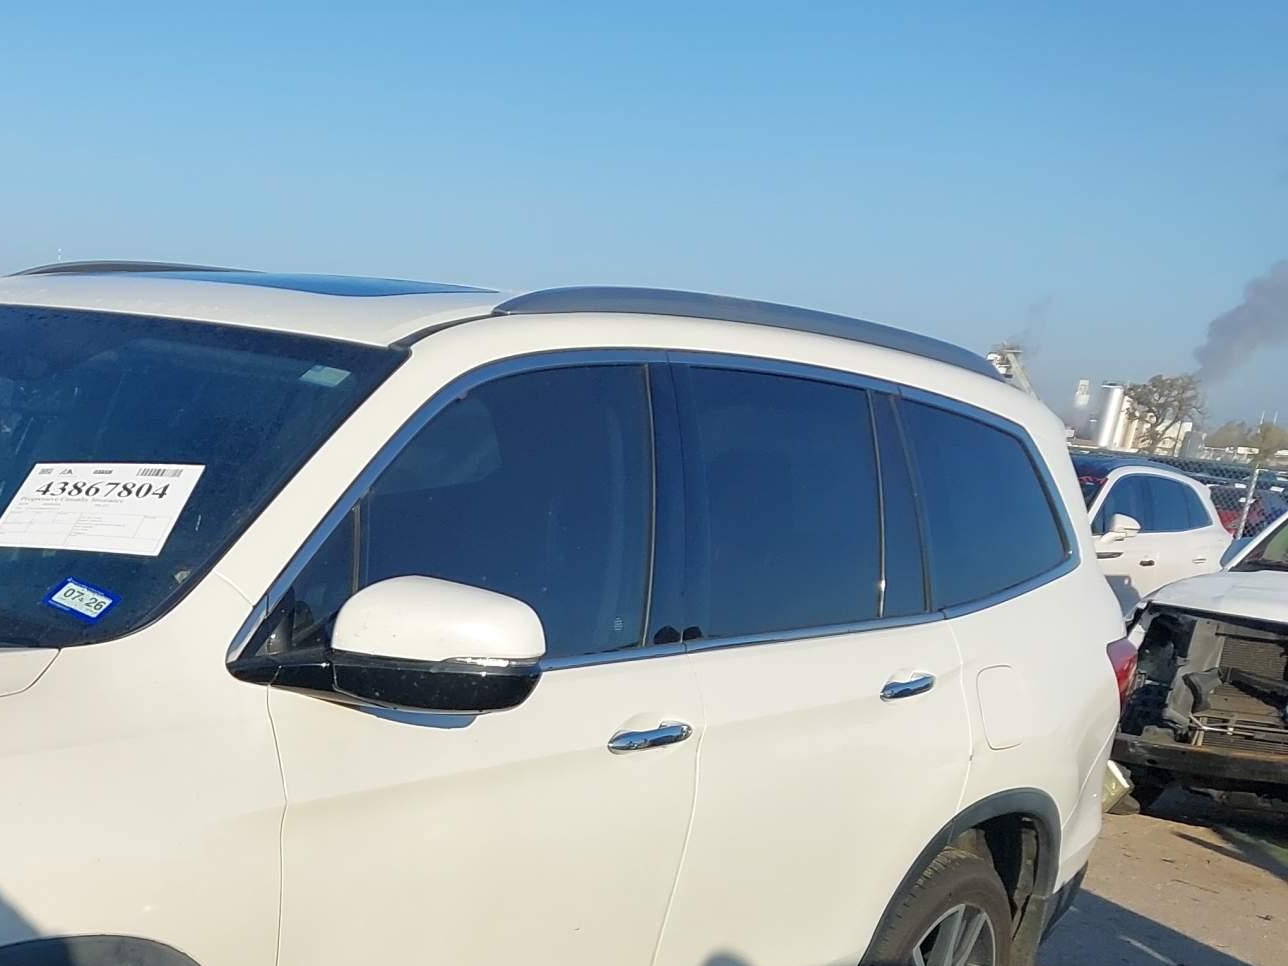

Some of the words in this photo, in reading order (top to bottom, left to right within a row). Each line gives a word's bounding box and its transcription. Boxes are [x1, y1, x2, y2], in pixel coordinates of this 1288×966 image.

[36, 481, 170, 499] 43867804
[63, 587, 85, 601] 07
[85, 597, 107, 611] 26
